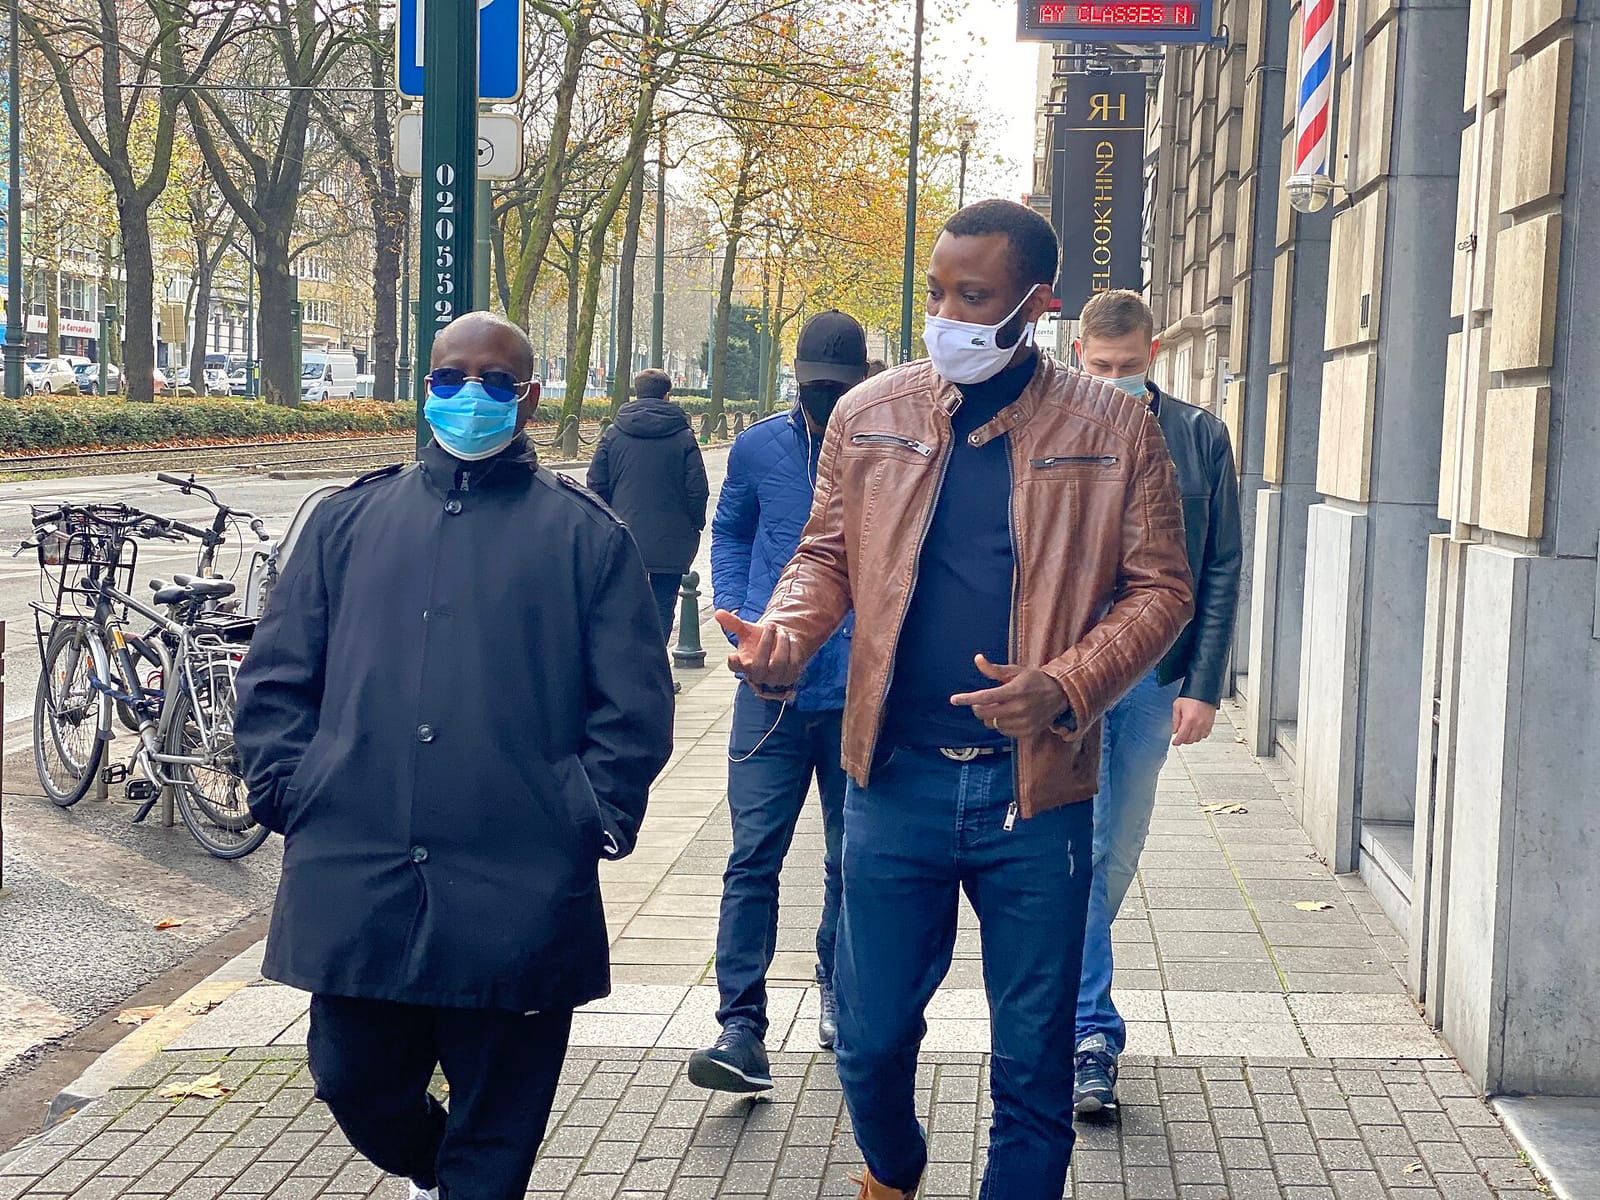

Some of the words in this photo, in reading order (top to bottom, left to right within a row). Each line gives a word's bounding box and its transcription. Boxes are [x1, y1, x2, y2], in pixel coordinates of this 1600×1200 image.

[1040, 5, 1066, 23] AY
[1078, 6, 1163, 23] CLASSES
[434, 163, 455, 338] 020552
[1092, 140, 1114, 292] ELOOK'HIND
